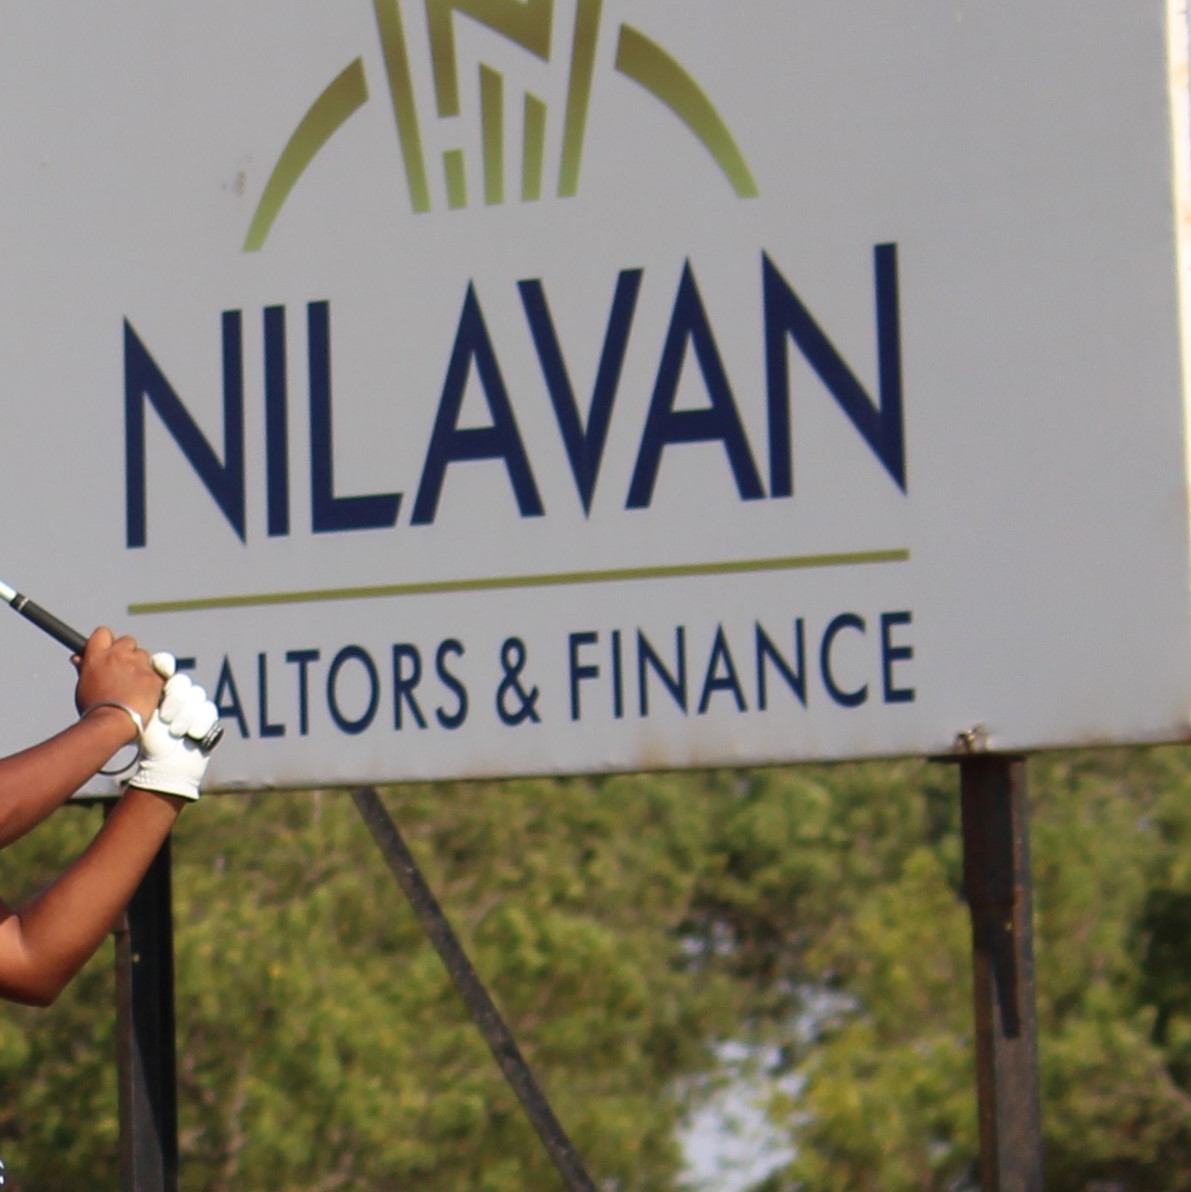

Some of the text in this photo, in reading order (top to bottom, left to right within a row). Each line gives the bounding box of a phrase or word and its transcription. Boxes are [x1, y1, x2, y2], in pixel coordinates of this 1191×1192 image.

[123, 242, 908, 548] NILAVAN
[174, 611, 916, 740] ALTORS & FINANCE
